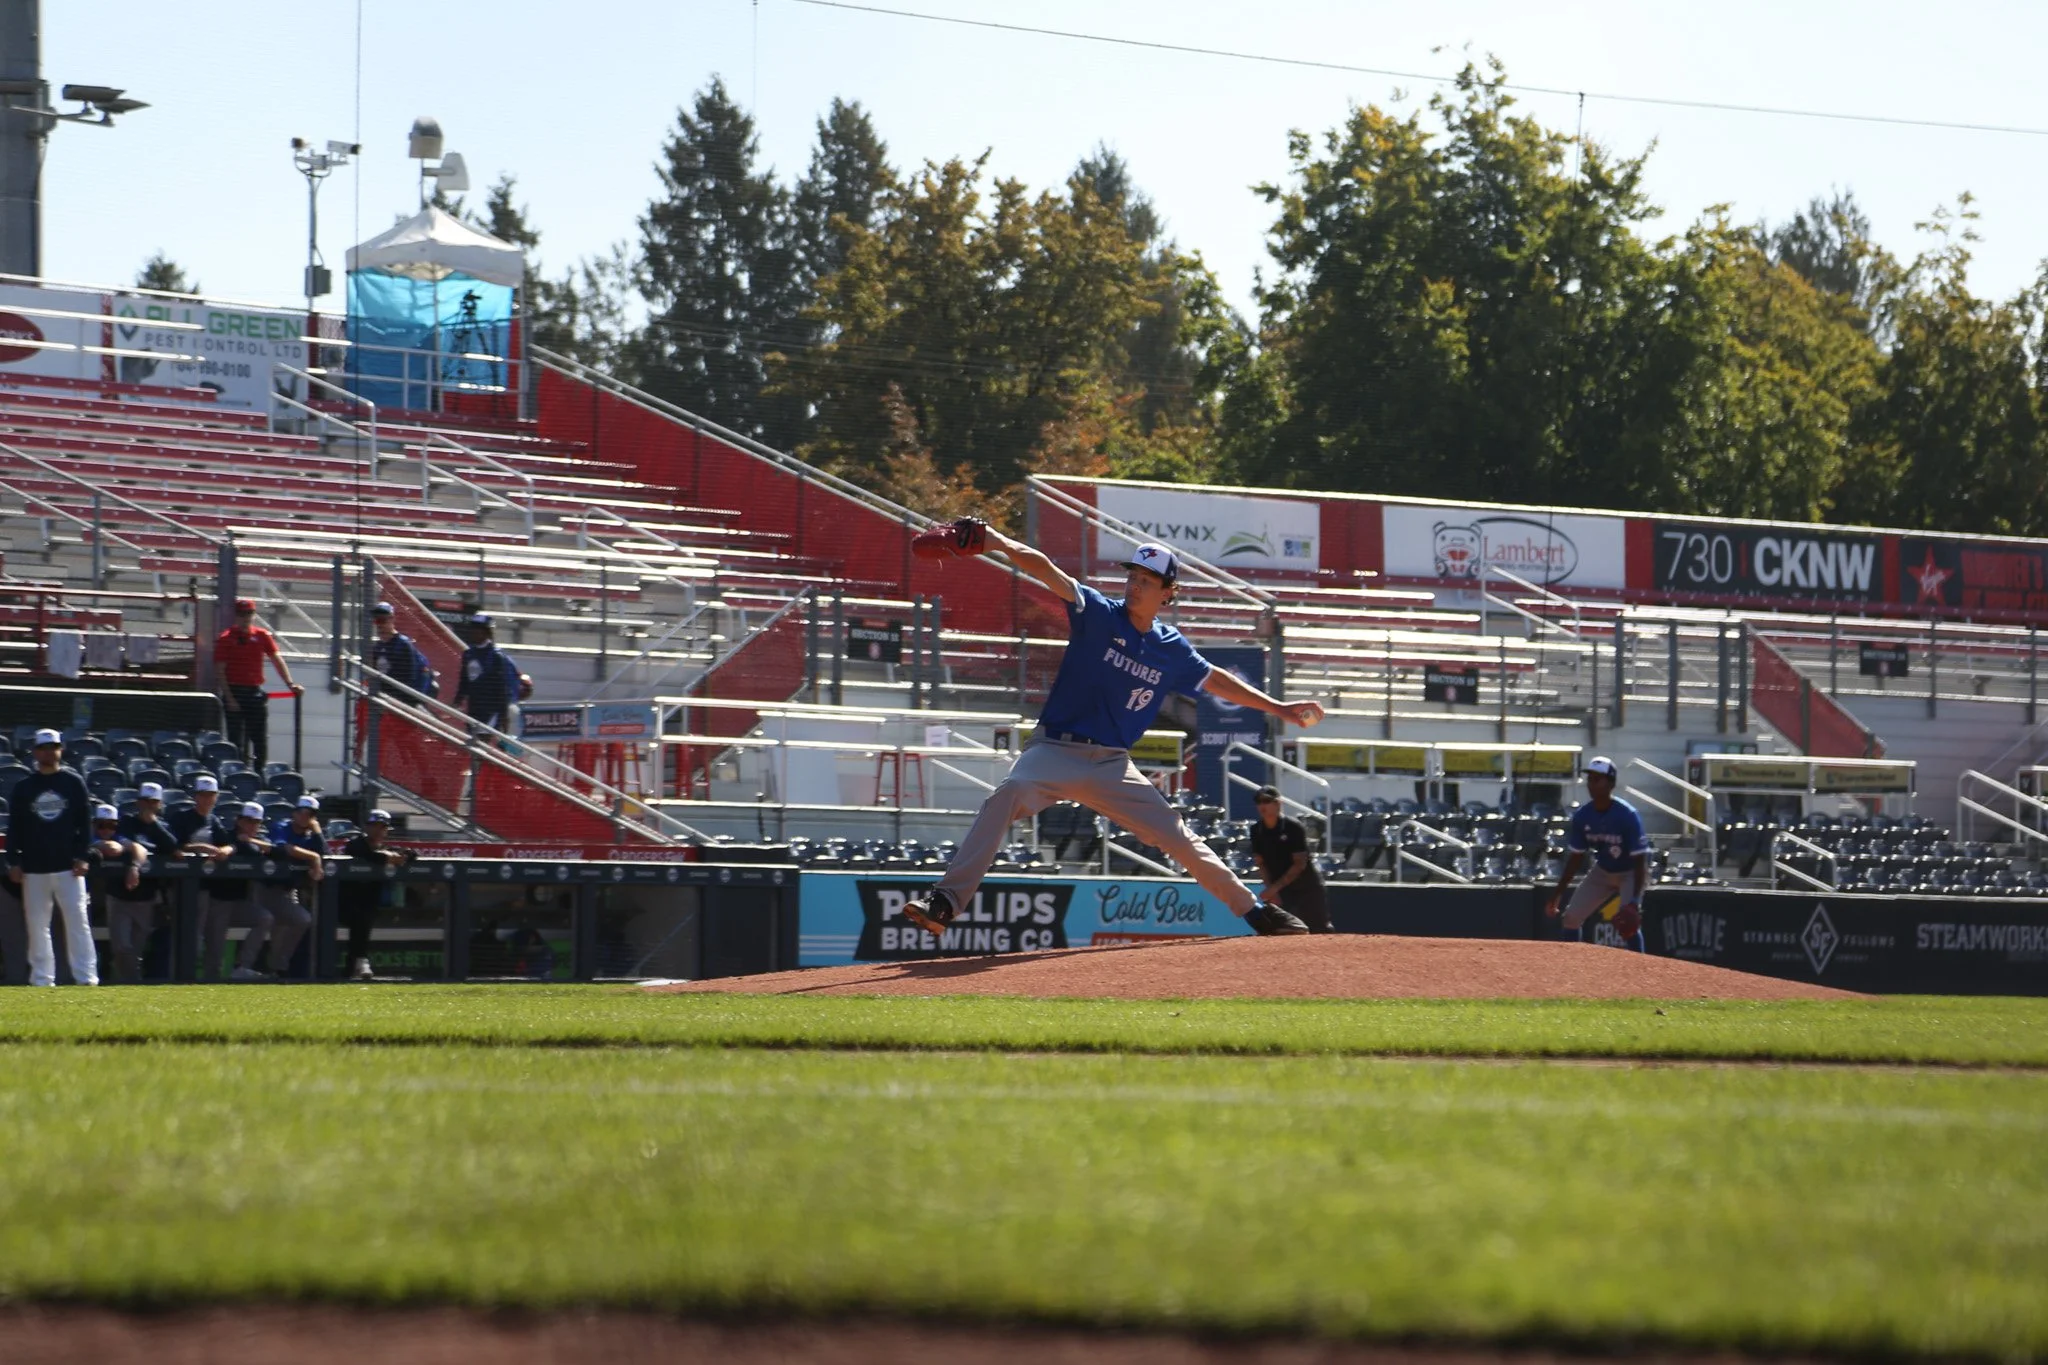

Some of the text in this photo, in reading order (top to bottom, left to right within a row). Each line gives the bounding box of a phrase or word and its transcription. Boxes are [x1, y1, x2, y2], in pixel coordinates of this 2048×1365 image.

[209, 312, 301, 339] GREEN
[145, 332, 301, 359] PEST ONTROL LTD
[1483, 536, 1565, 564] Lambert
[1662, 531, 1875, 591] 730 CKNW
[1103, 648, 1163, 686] FUTURES
[1126, 687, 1155, 713] 19
[1097, 884, 1150, 924] Cold
[1154, 886, 1207, 924] Beer
[881, 927, 1009, 951] BREWING
[1662, 912, 1727, 951] HOYNE
[1916, 923, 2048, 951] STEAMWORK
